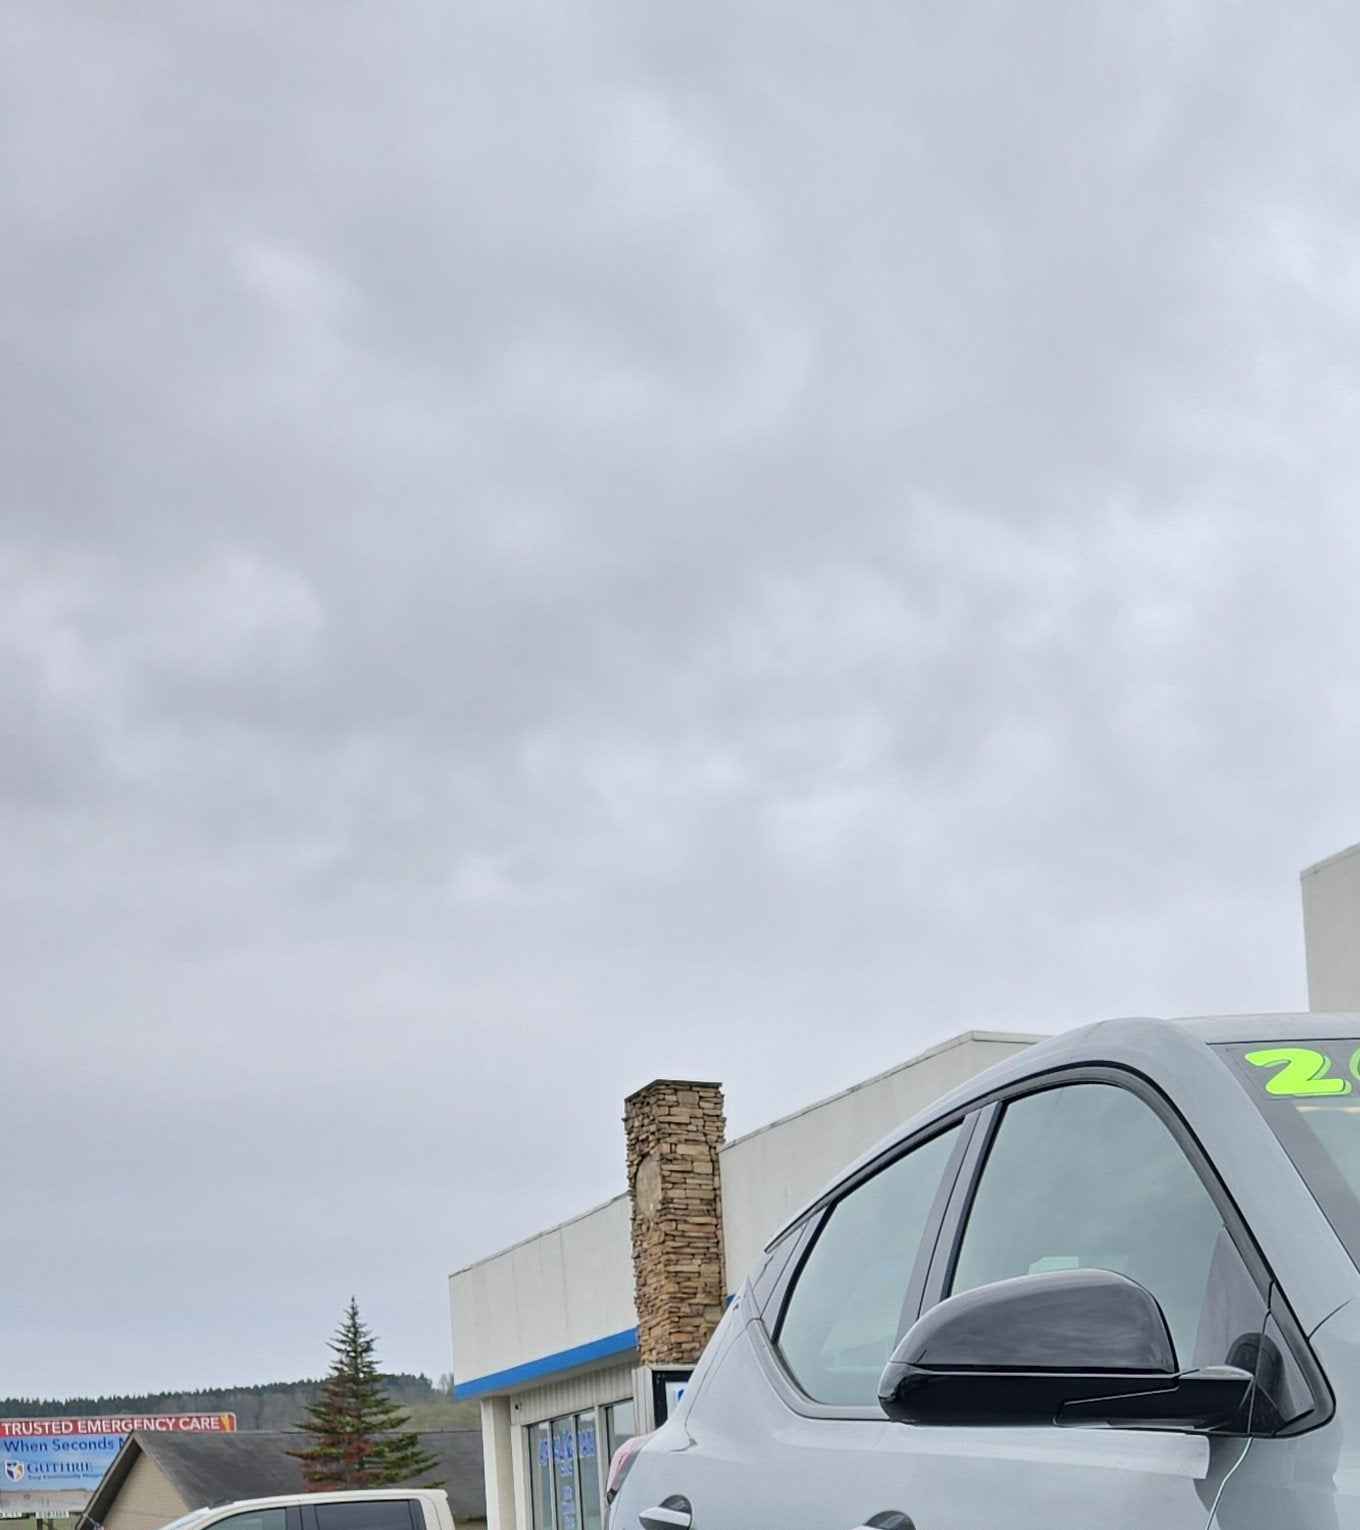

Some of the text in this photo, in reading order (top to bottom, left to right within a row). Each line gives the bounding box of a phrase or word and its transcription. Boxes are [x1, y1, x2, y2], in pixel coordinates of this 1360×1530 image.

[2, 1416, 220, 1436] TRUSTED EMERGENCY CARE
[4, 1439, 48, 1453] When
[52, 1437, 114, 1452] Seconds
